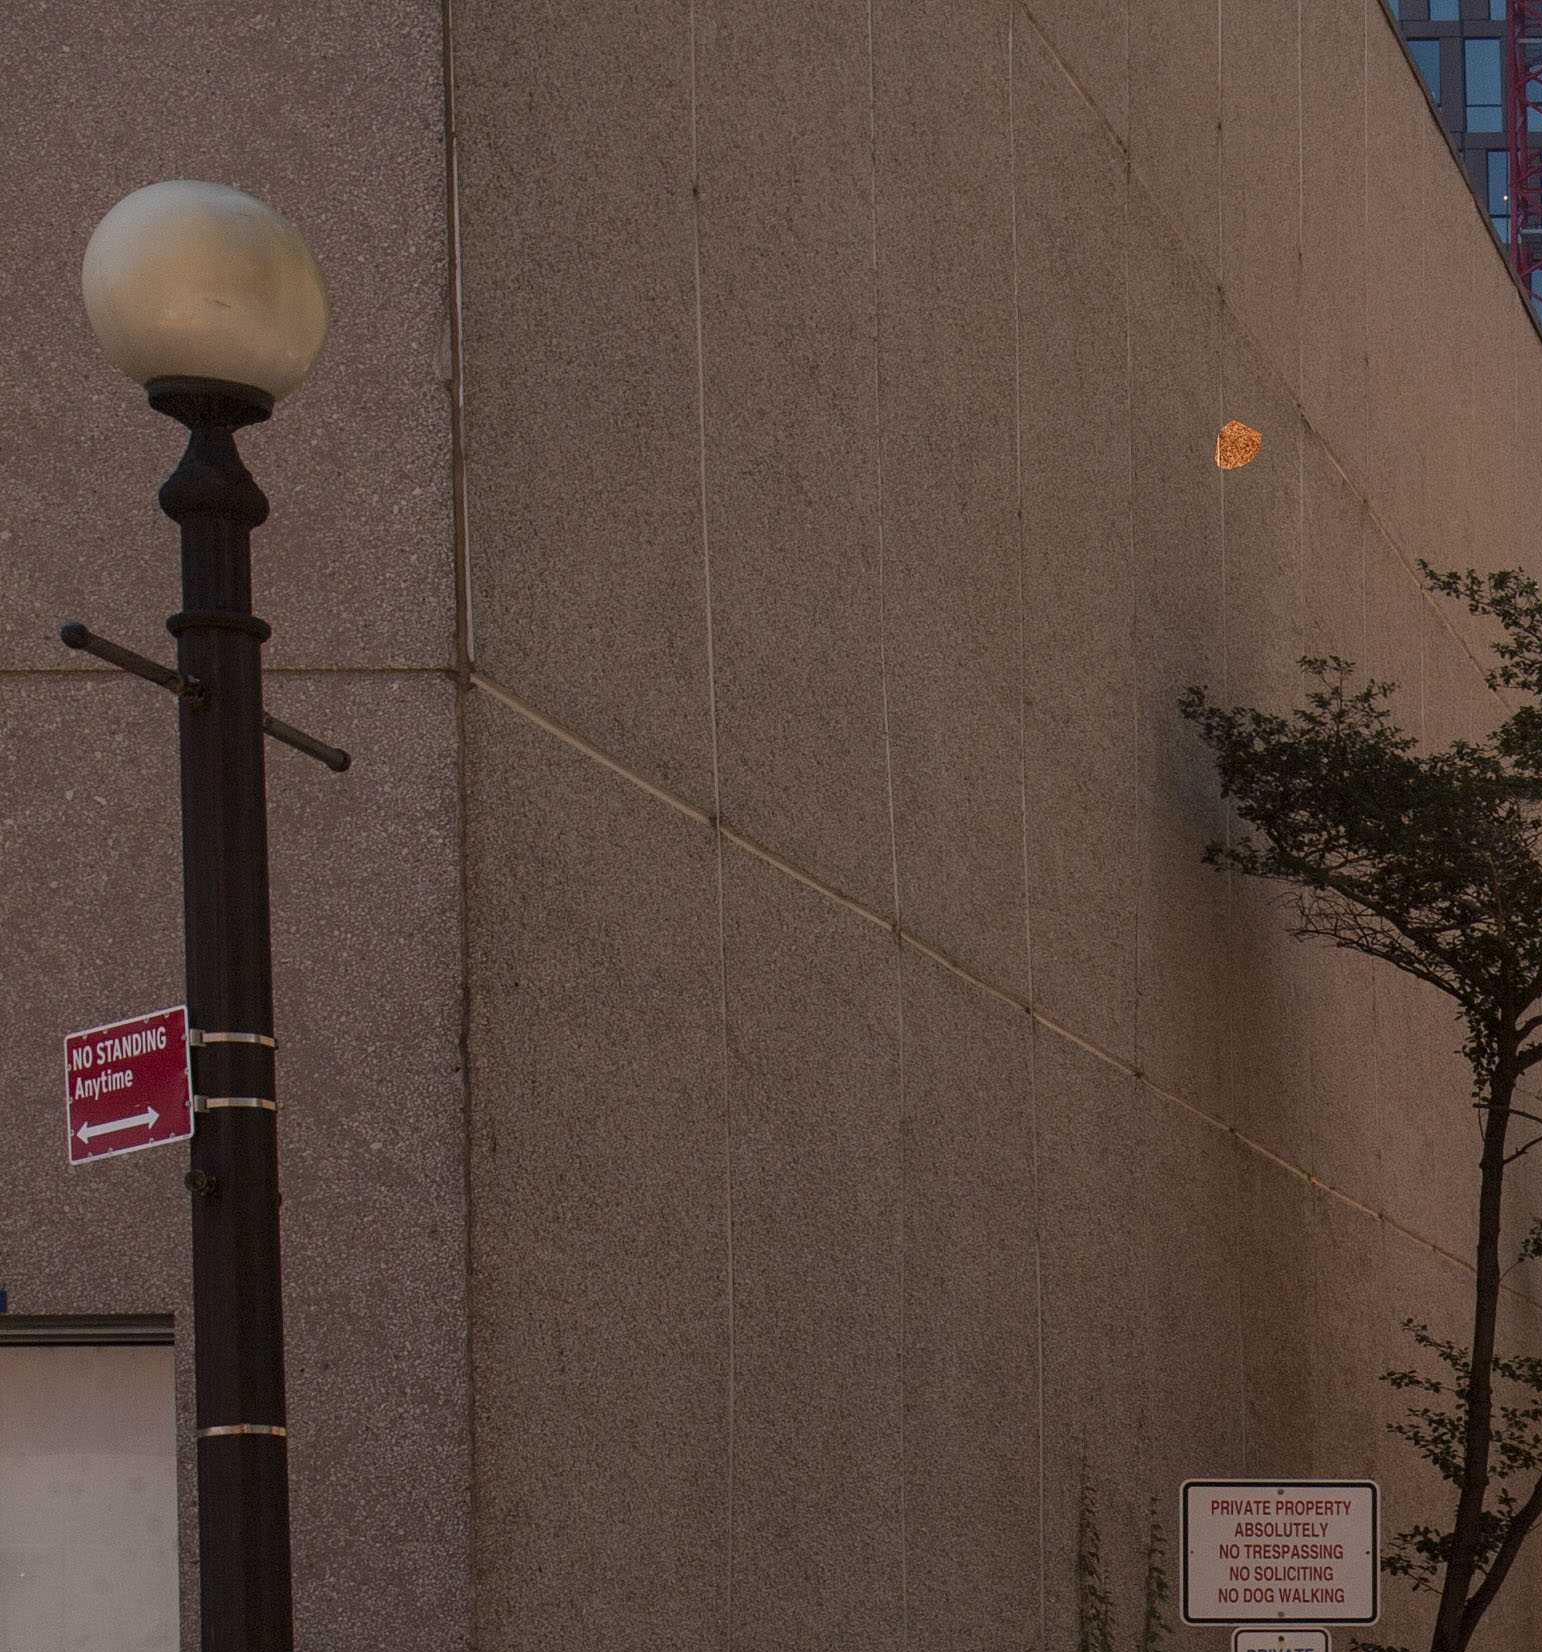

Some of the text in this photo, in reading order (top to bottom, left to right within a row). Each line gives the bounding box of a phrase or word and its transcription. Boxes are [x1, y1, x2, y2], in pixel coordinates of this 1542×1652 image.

[72, 1026, 167, 1072] NO STANDING
[75, 1066, 134, 1101] Anytime
[1211, 1500, 1352, 1516] PRIVATE PROPERTY
[1234, 1522, 1329, 1538] ABSOLUTELY
[1218, 1544, 1344, 1561] NO TRESPASSING
[1229, 1566, 1334, 1582] NO SOLICITING
[1218, 1588, 1345, 1604] NO DOG WALKING
